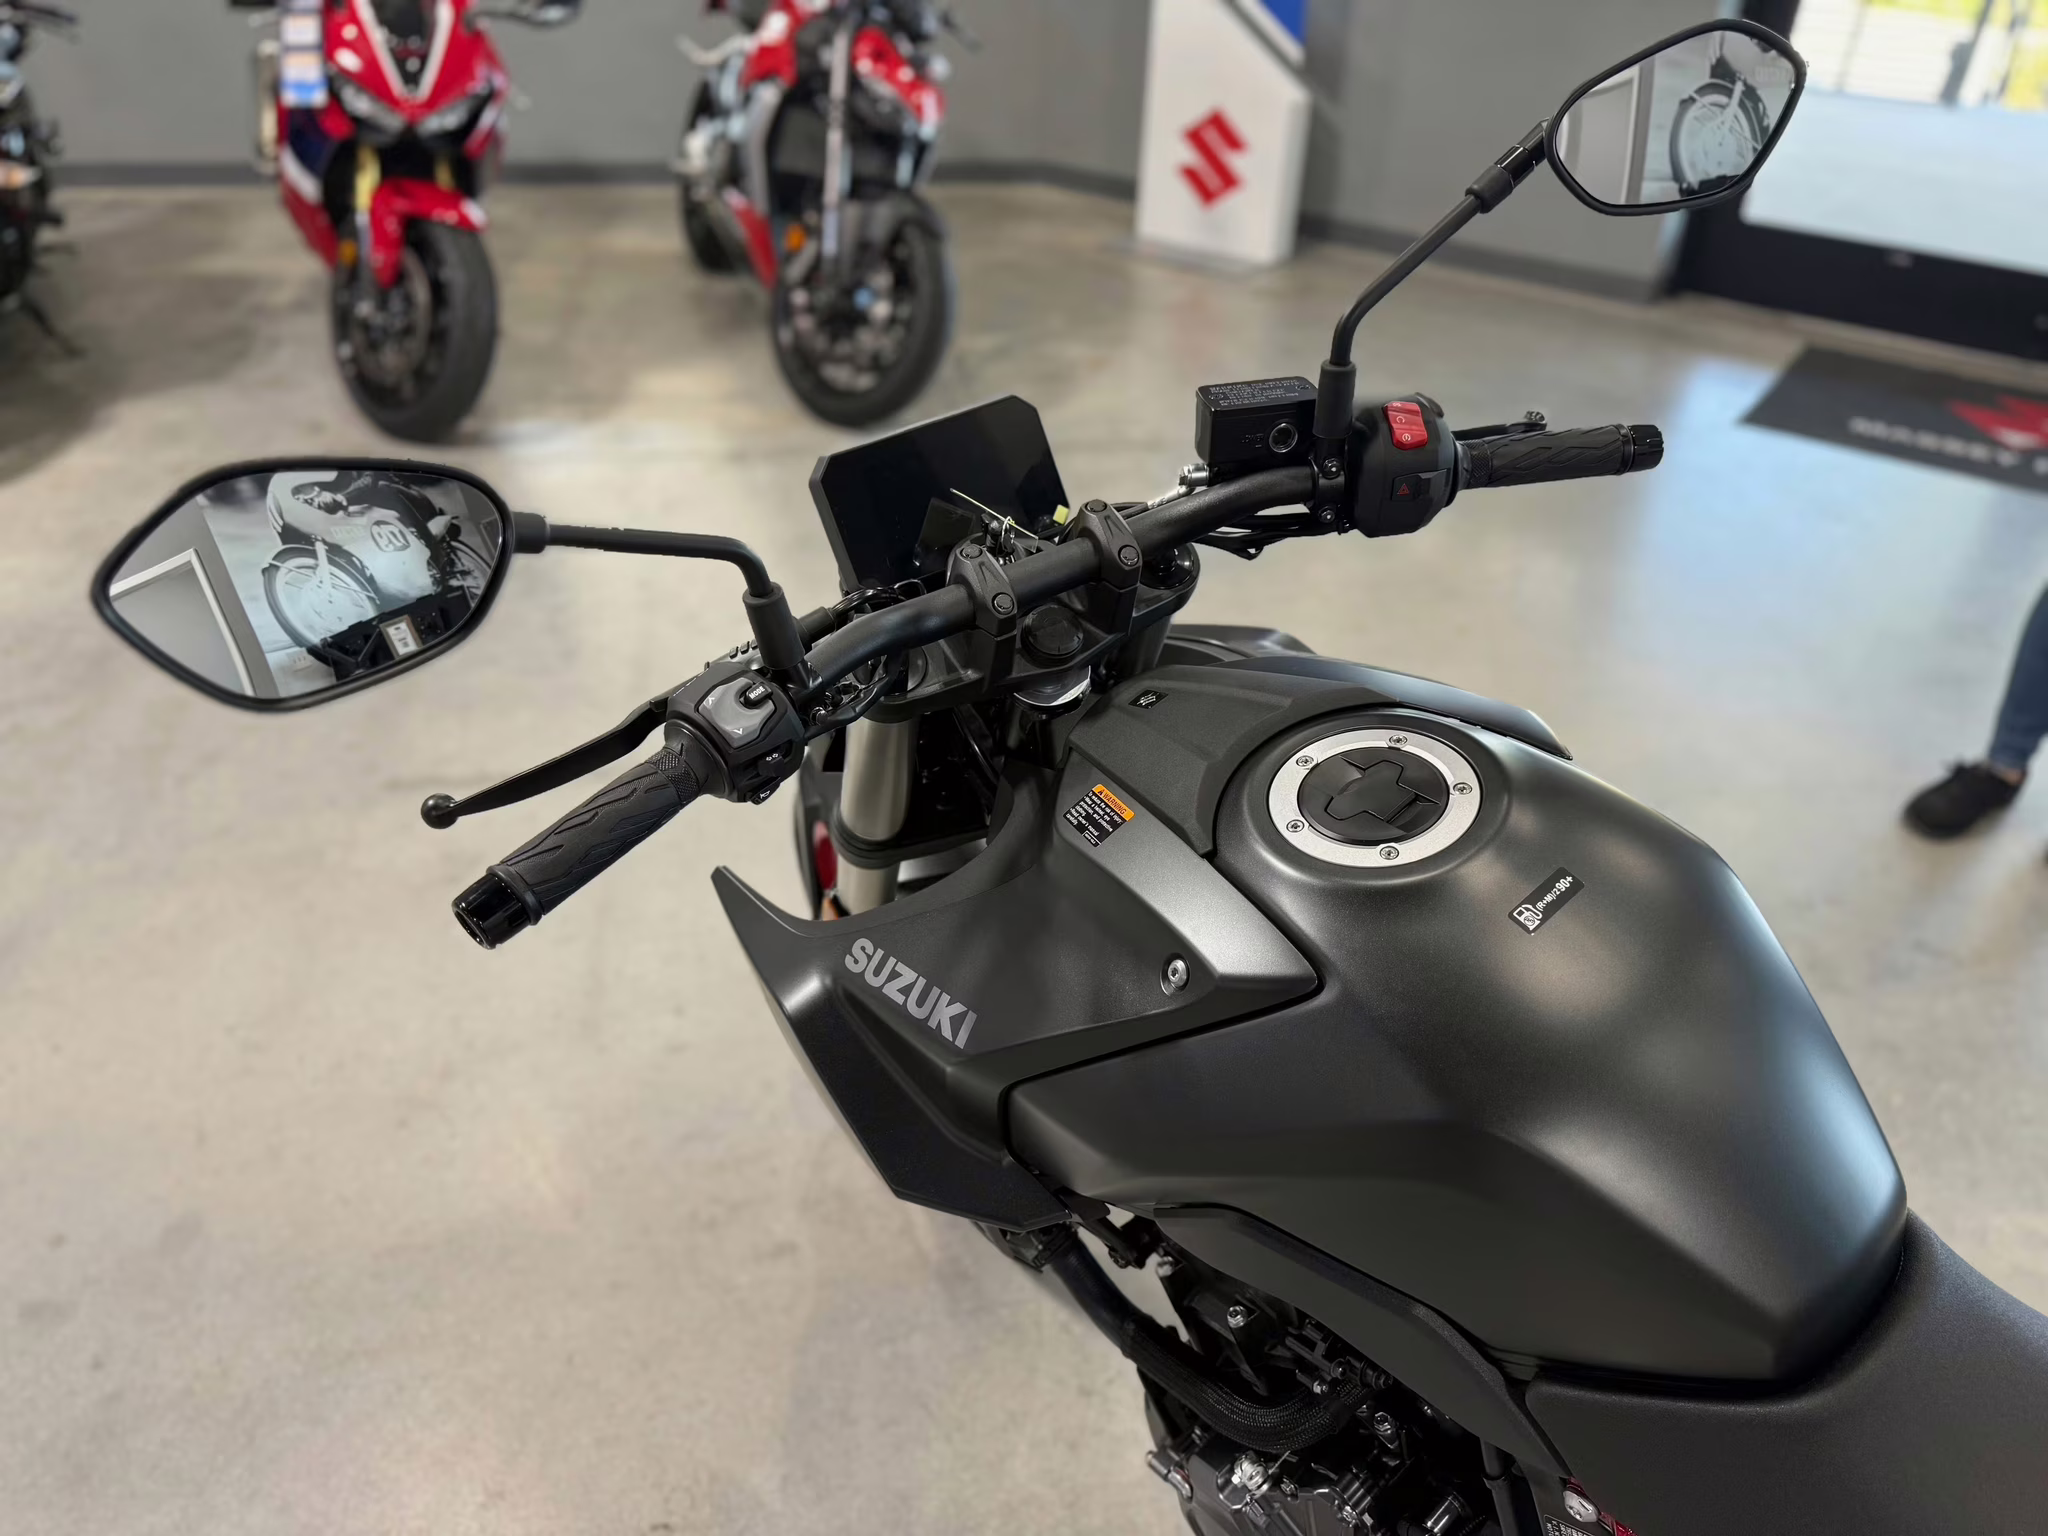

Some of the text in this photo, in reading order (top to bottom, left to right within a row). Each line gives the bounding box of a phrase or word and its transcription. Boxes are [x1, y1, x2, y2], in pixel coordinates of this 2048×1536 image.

[749, 685, 765, 700] MODE
[1103, 793, 1127, 814] WARNING
[1536, 876, 1573, 912] (R+M)/2 90+
[844, 937, 978, 1050] SUZUKI
